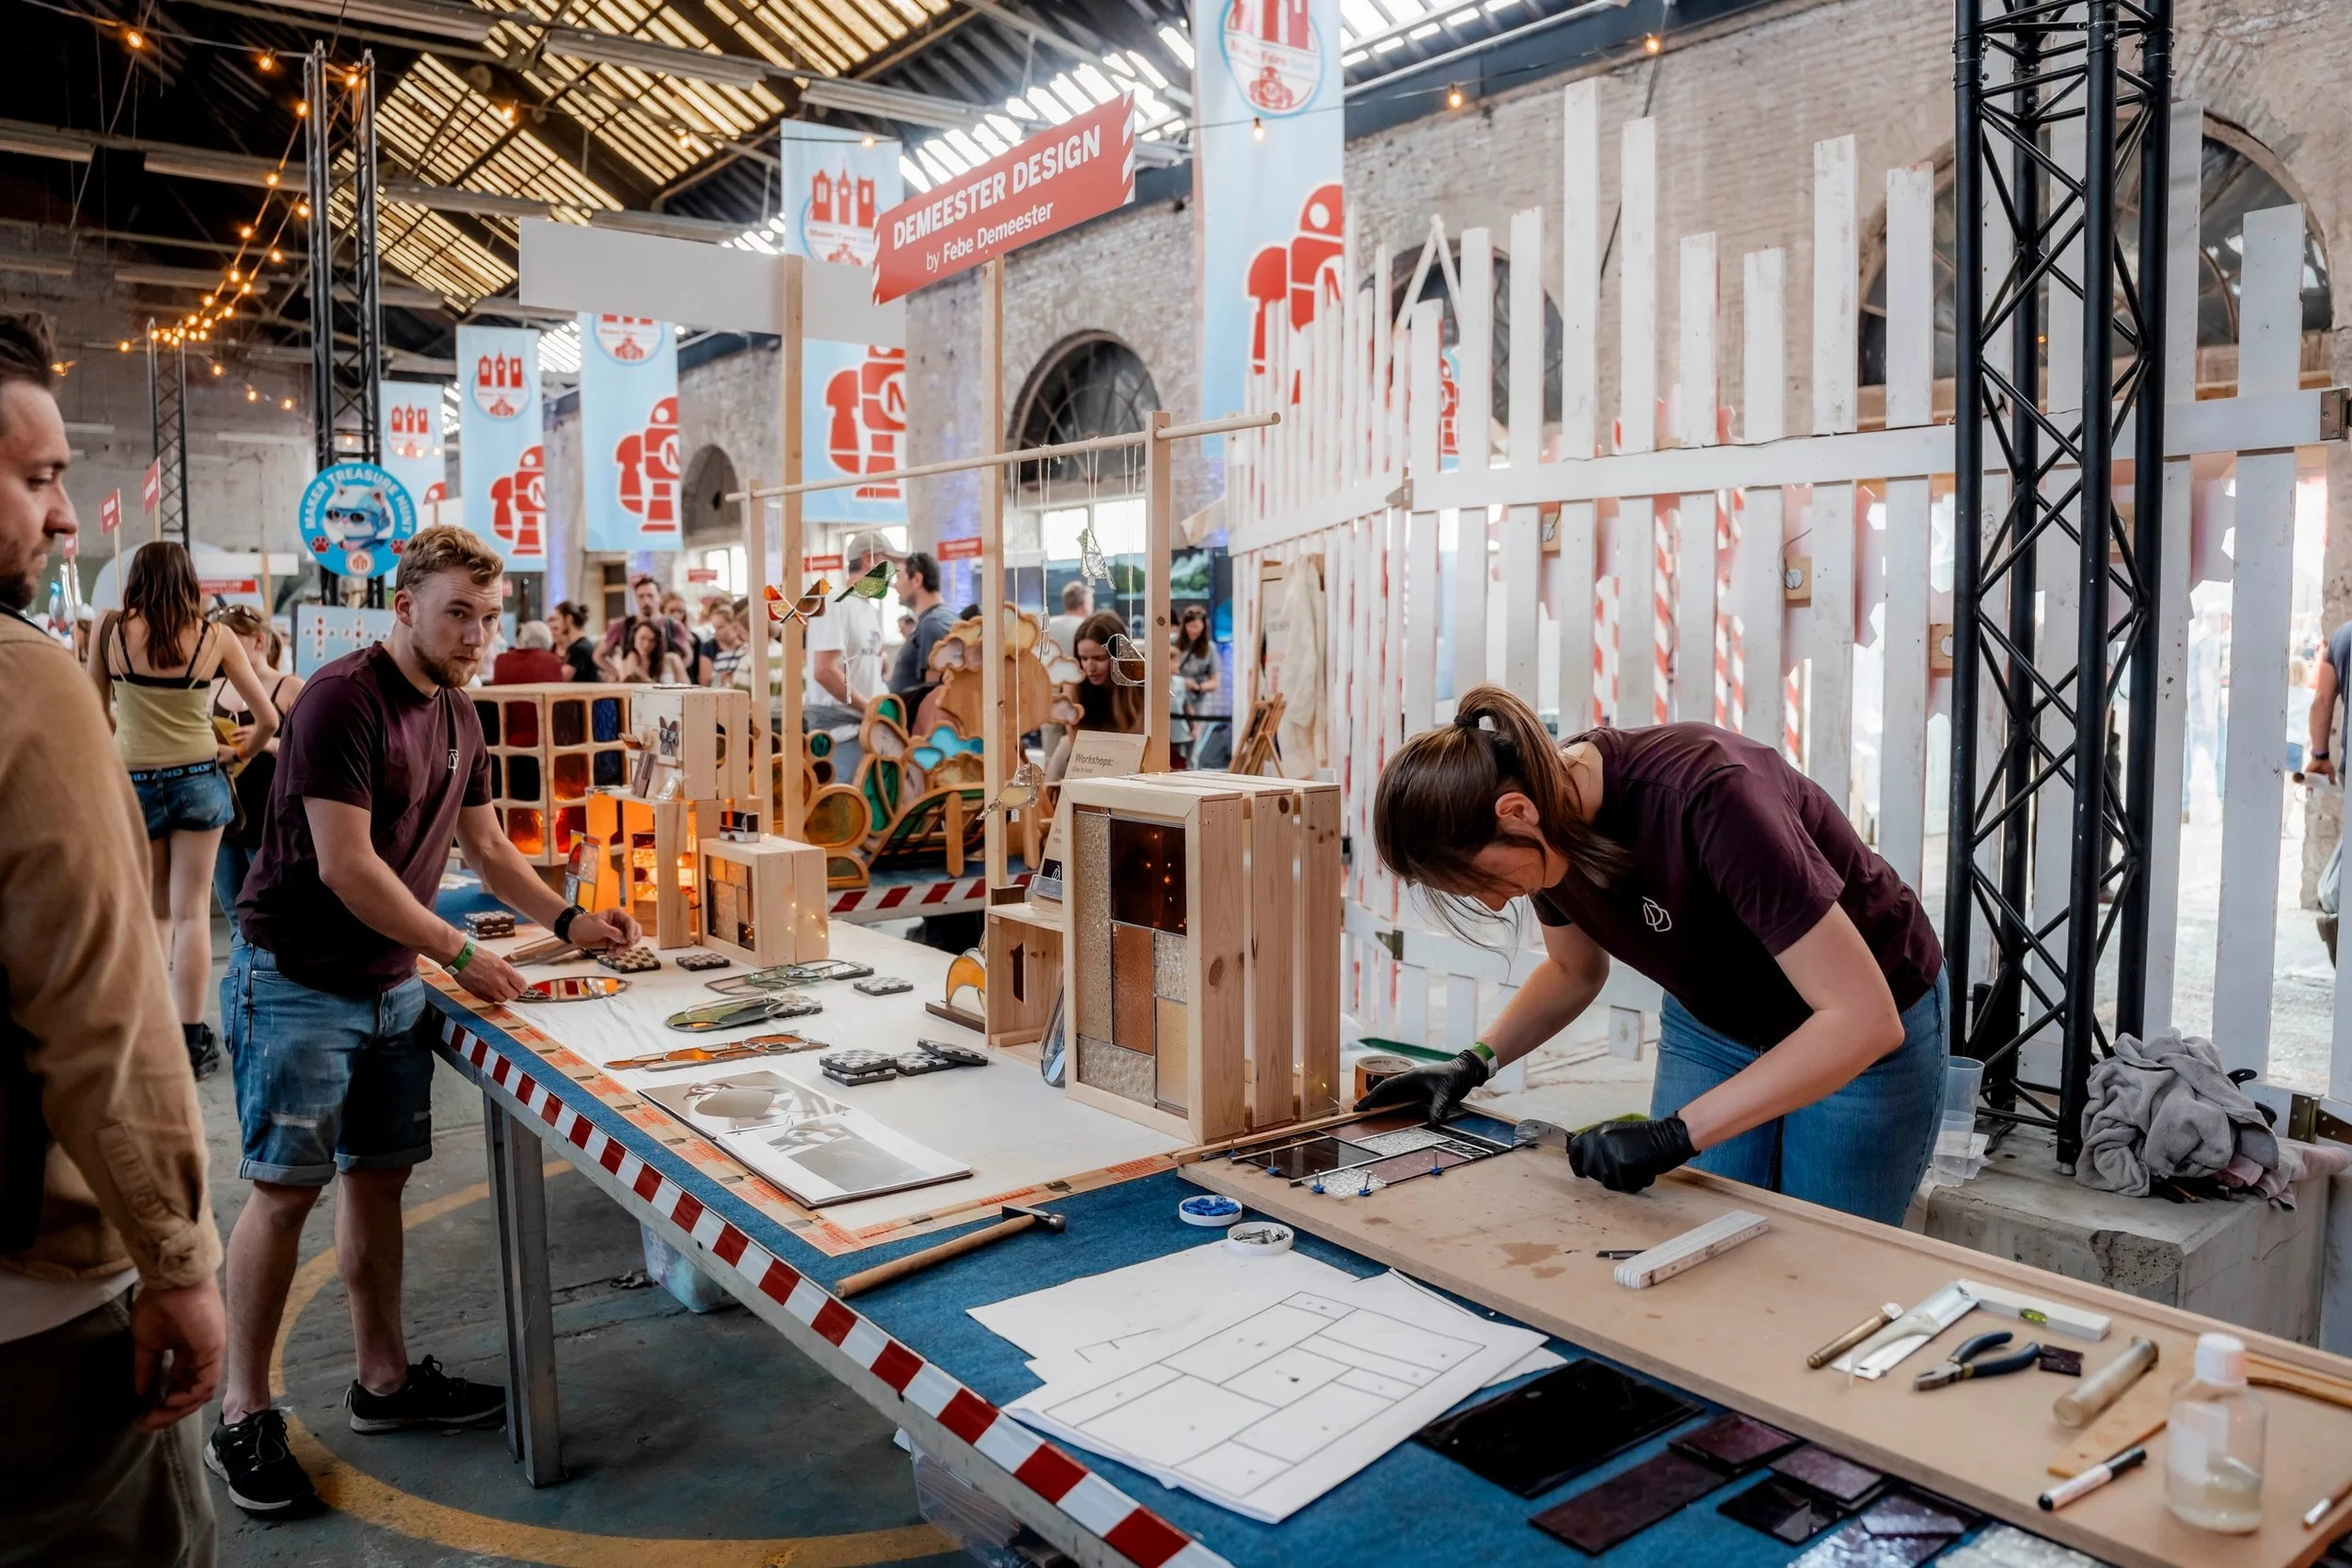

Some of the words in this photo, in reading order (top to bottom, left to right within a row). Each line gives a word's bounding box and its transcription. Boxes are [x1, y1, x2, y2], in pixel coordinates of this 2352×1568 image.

[893, 171, 1007, 251] DEMEESTER
[1012, 124, 1101, 196] DESIGN
[926, 251, 942, 274] by
[943, 236, 974, 264] Febe
[977, 201, 1054, 250] Demeester
[304, 481, 329, 531] MAKER
[326, 467, 400, 497] TREASURE
[395, 494, 413, 535] HUNT
[1074, 752, 1115, 768] Workshops:
